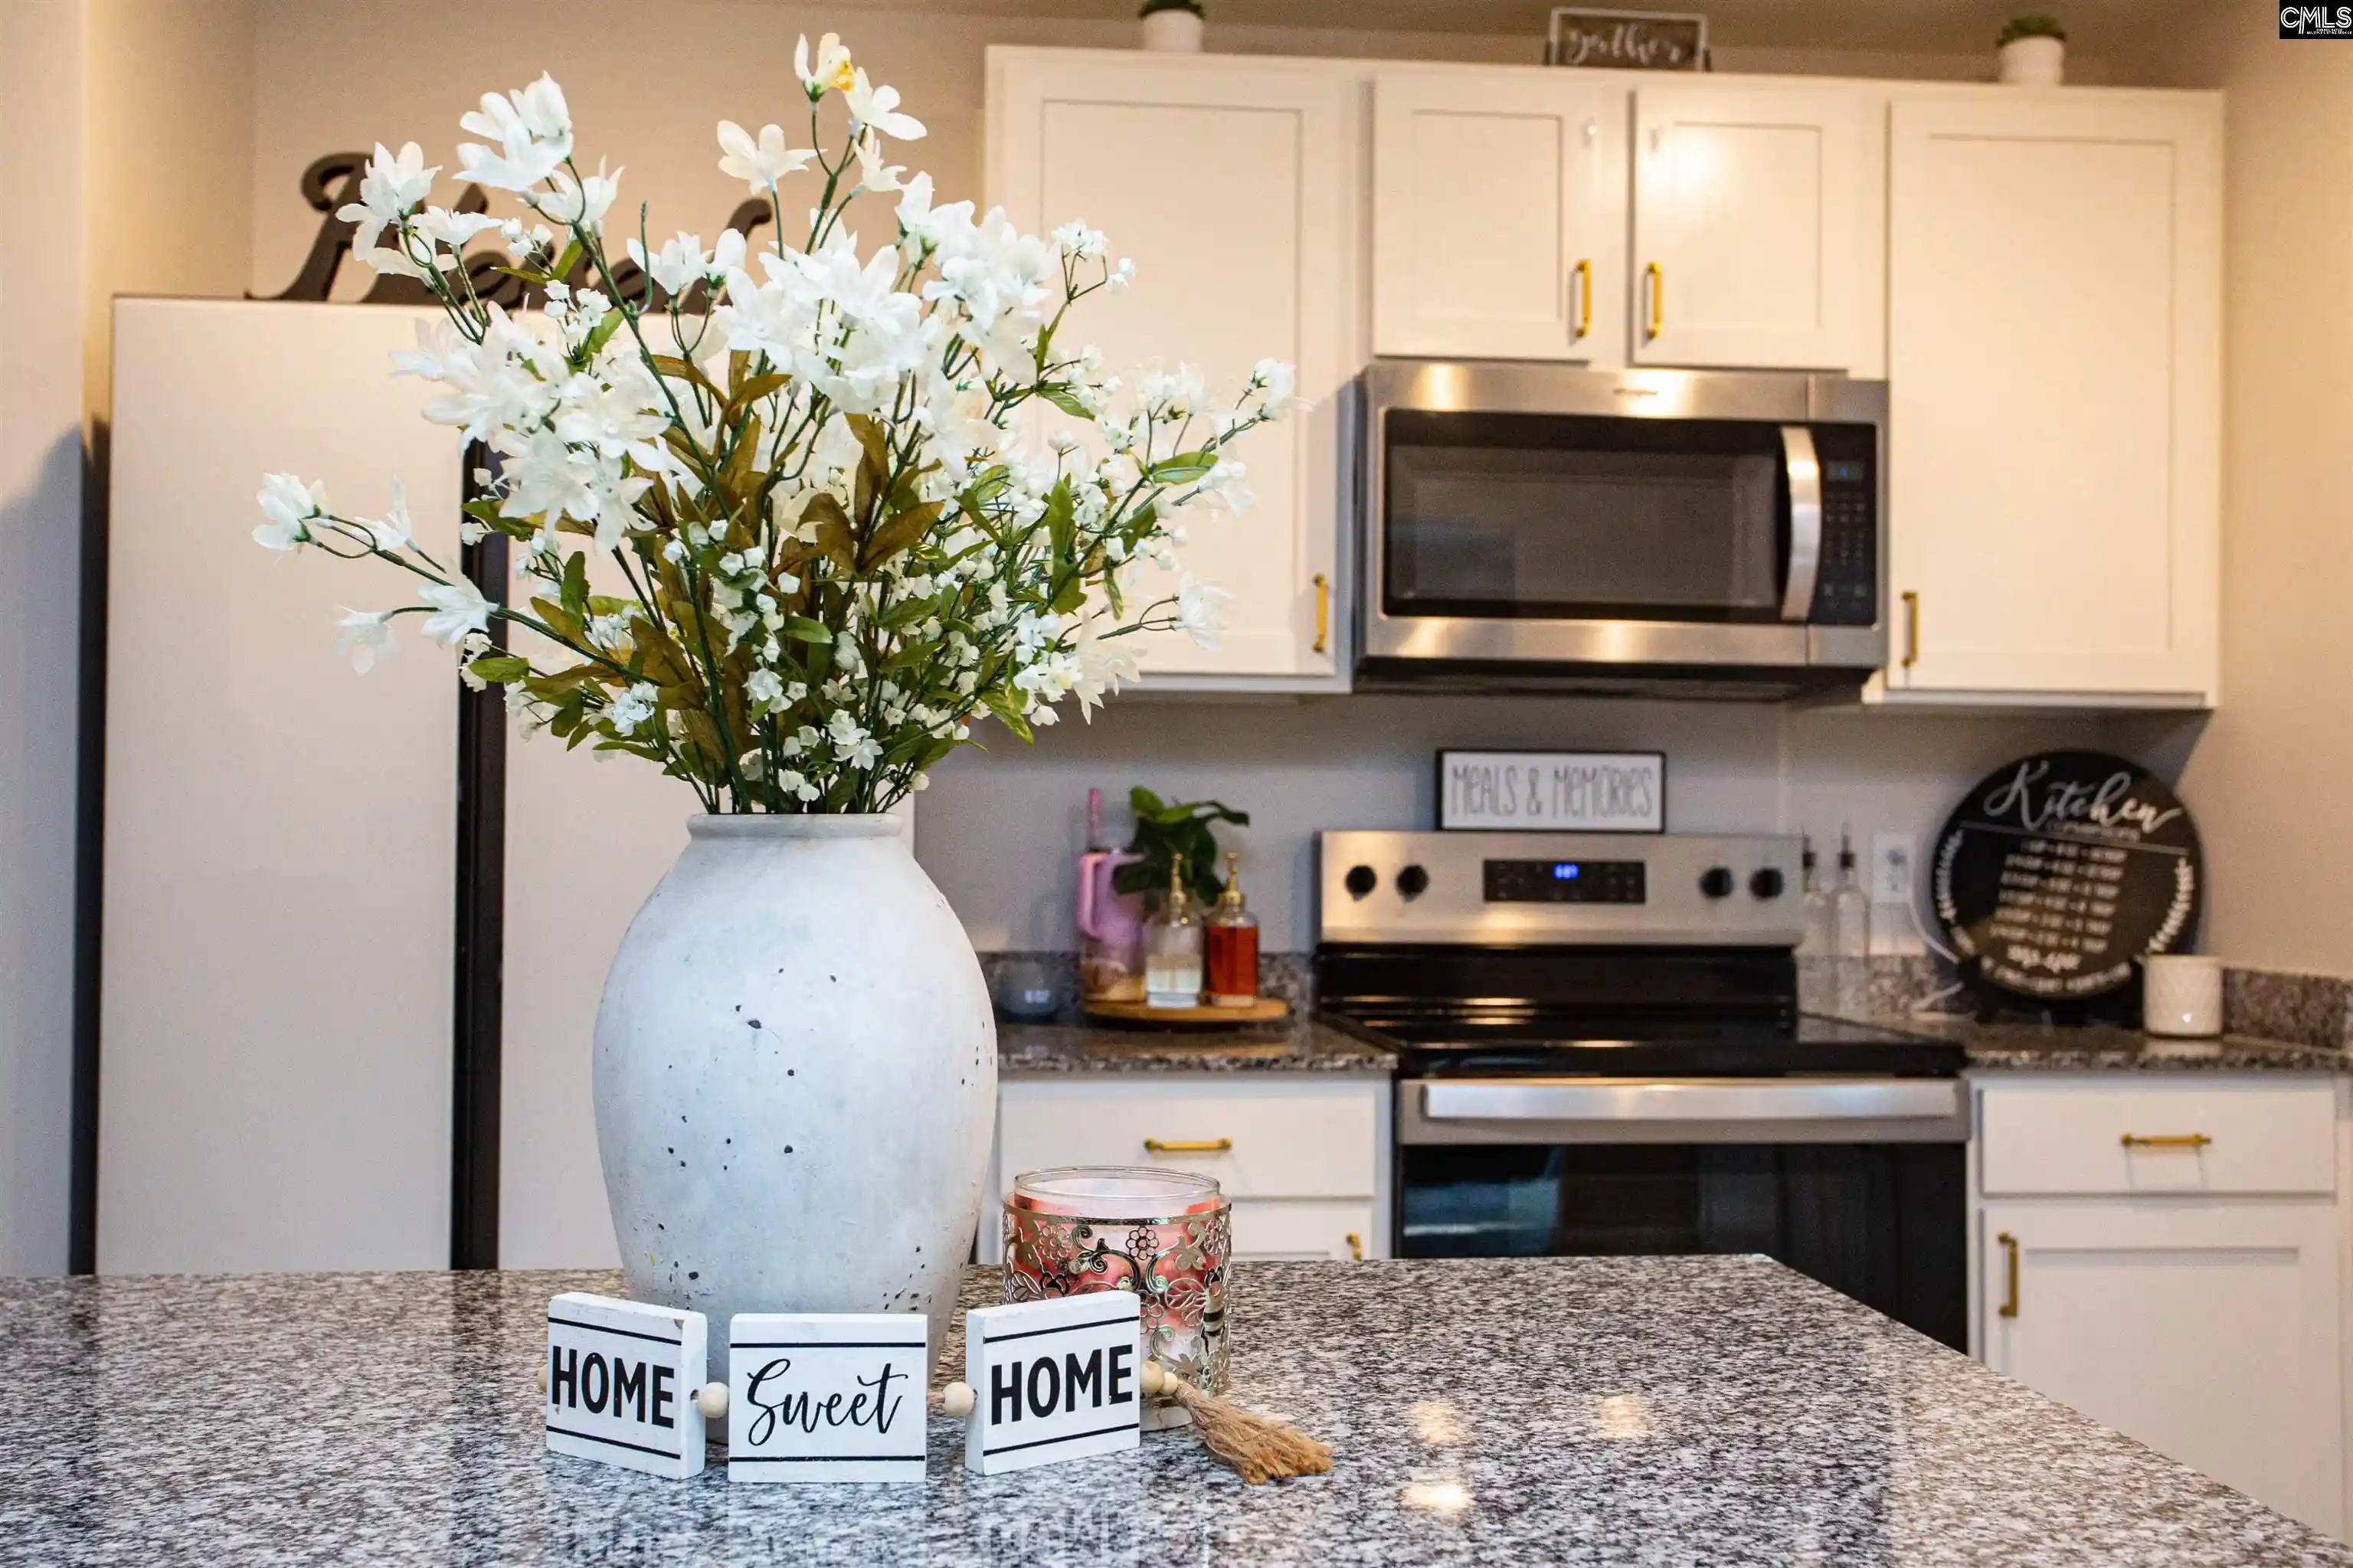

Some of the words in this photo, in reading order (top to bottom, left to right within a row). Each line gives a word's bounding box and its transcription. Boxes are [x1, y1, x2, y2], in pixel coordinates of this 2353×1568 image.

[1451, 764, 1518, 817] MEALS
[1526, 766, 1544, 817] &
[1552, 764, 1654, 819] MEMORIES
[1983, 760, 2183, 834] Kitchen
[551, 1345, 675, 1429] HOME
[747, 1358, 909, 1446] Sweet
[991, 1344, 1133, 1426] HOME
